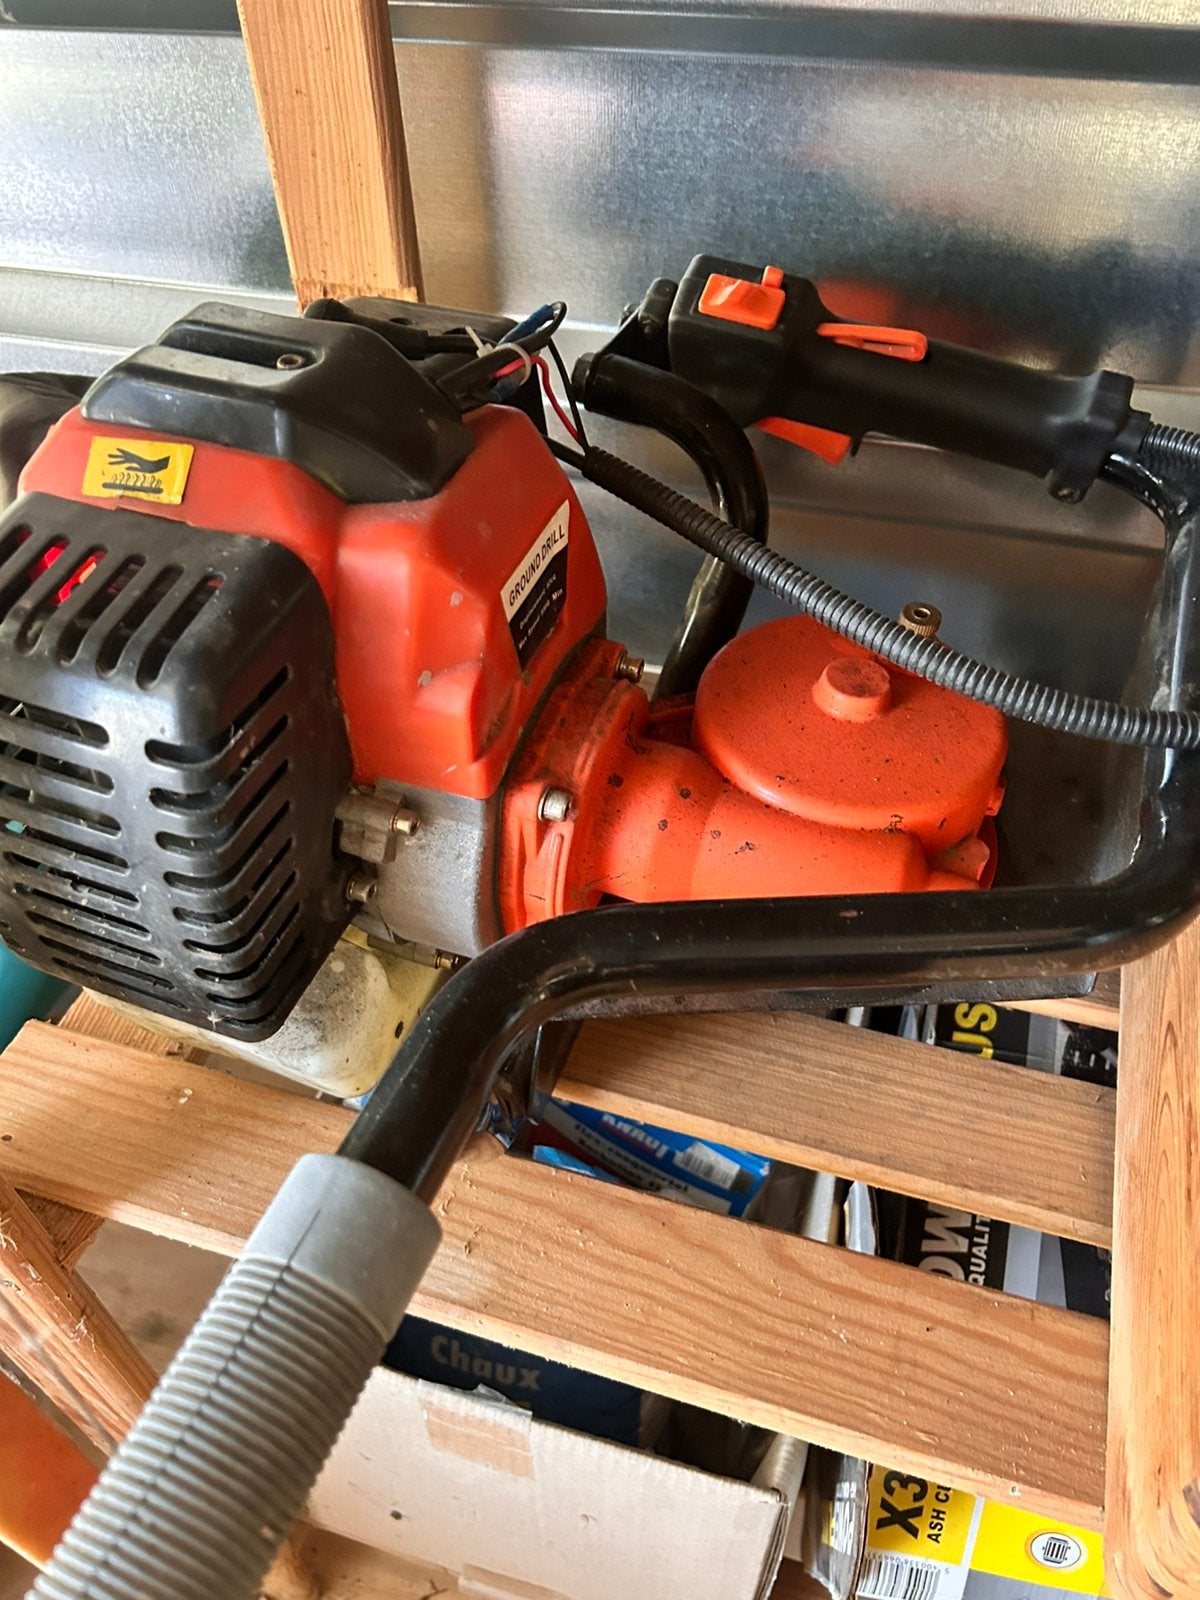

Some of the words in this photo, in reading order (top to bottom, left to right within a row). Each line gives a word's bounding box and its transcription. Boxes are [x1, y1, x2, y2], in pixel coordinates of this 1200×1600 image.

[509, 553, 541, 607] GROUND
[541, 525, 565, 560] DRILL
[431, 1335, 541, 1391] Chaux
[876, 1470, 928, 1540] X3
[927, 1508, 947, 1544] ASH
